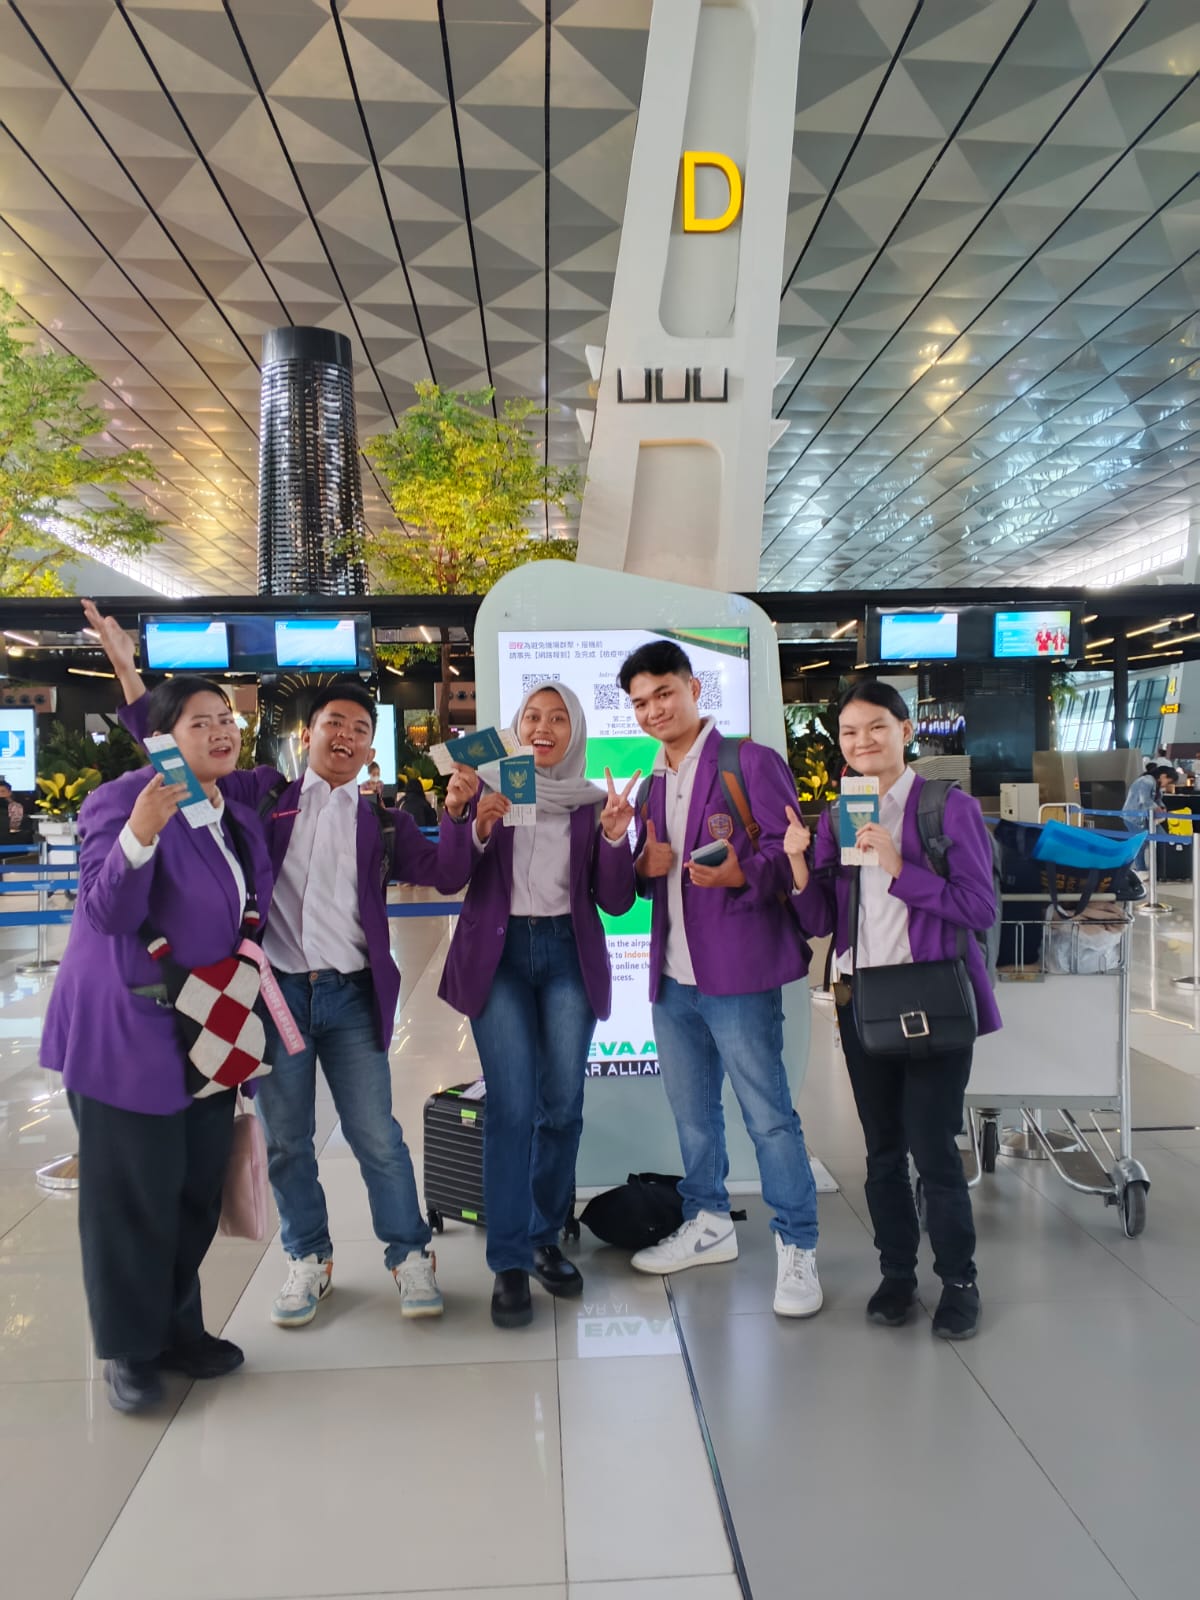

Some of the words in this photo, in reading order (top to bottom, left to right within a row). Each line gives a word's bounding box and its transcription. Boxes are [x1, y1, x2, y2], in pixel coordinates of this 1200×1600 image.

[683, 150, 743, 234] D
[608, 939, 616, 948] in
[617, 939, 630, 948] the
[615, 951, 623, 959] to
[615, 961, 640, 970] online
